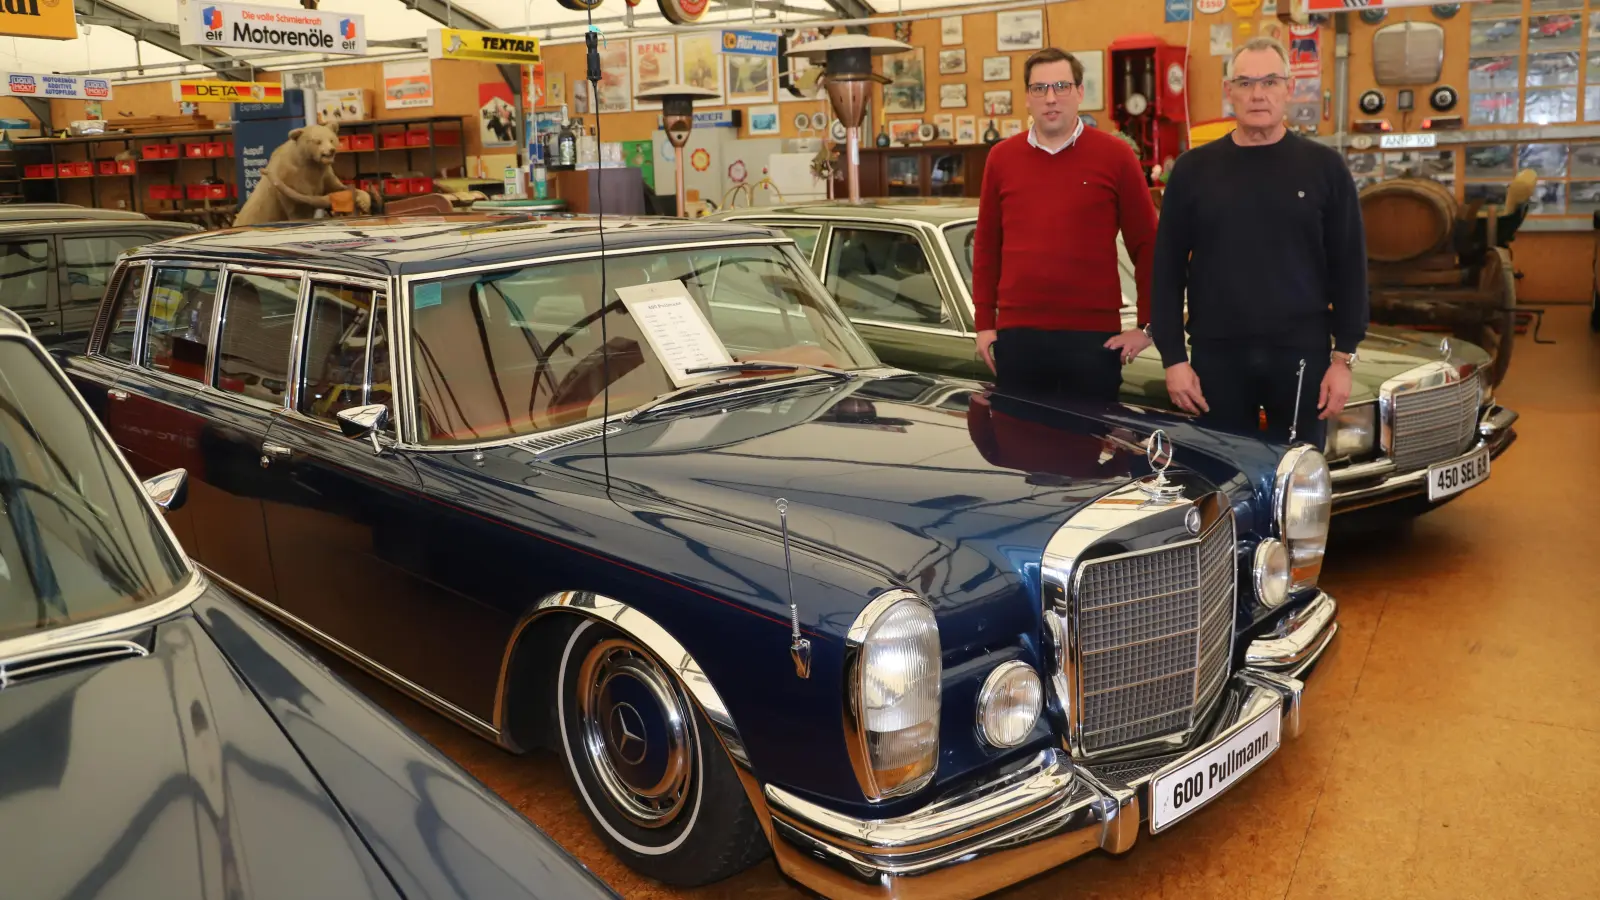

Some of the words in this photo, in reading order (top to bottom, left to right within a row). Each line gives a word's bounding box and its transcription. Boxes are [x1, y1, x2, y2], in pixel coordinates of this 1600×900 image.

[242, 10, 255, 20] Die
[256, 12, 274, 22] volle
[276, 14, 322, 26] Schmierkraft
[205, 30, 223, 41] elf
[233, 22, 334, 48] Motorenöle
[342, 40, 355, 50] elf
[482, 36, 534, 53] TEXTAR
[637, 42, 667, 55] BENZ
[196, 85, 238, 96] DETA
[1437, 466, 1459, 490] 450
[1461, 460, 1476, 484] SEL
[1173, 771, 1204, 809] 600
[1208, 731, 1269, 789] Pullmann
